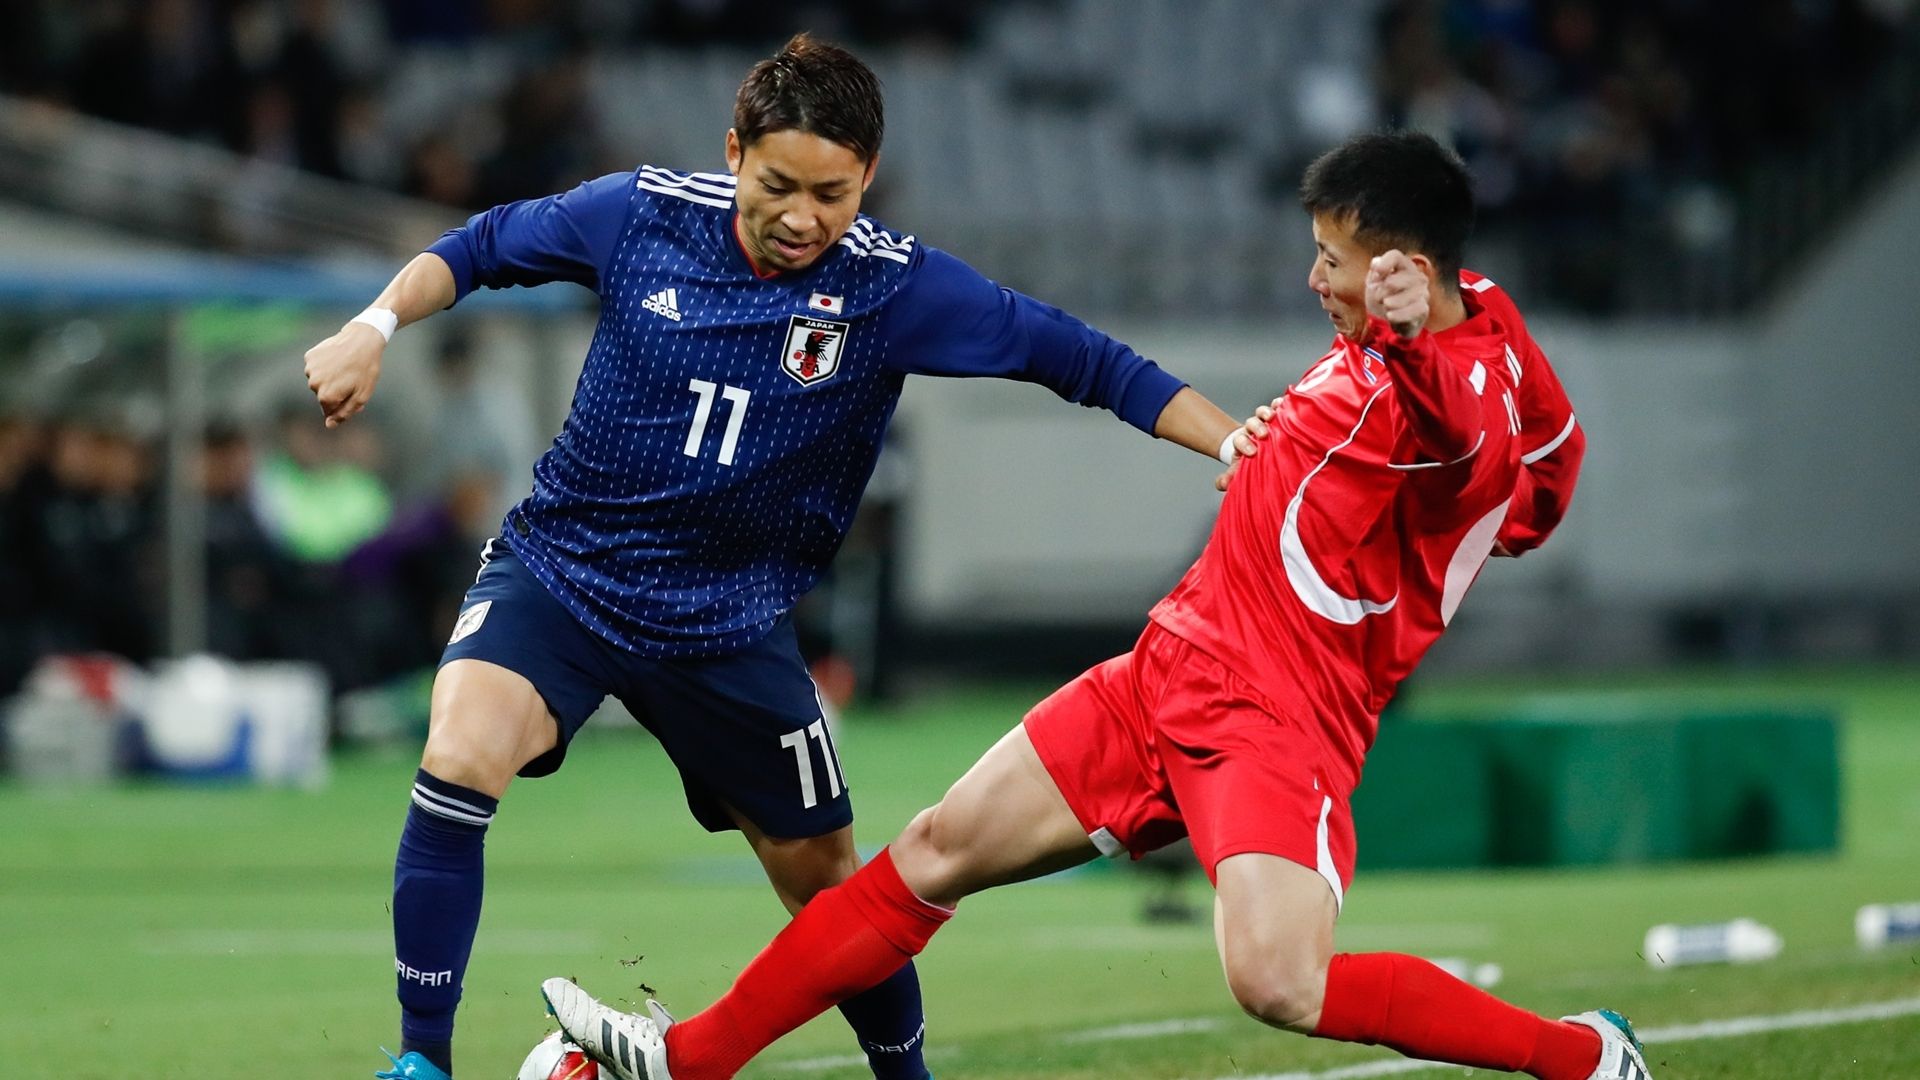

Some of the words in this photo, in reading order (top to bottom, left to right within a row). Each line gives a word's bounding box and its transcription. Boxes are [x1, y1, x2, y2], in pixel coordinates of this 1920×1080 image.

[641, 298, 682, 322] adidas
[805, 320, 835, 330] JAPAN
[683, 378, 751, 467] 11
[780, 717, 841, 809] 11
